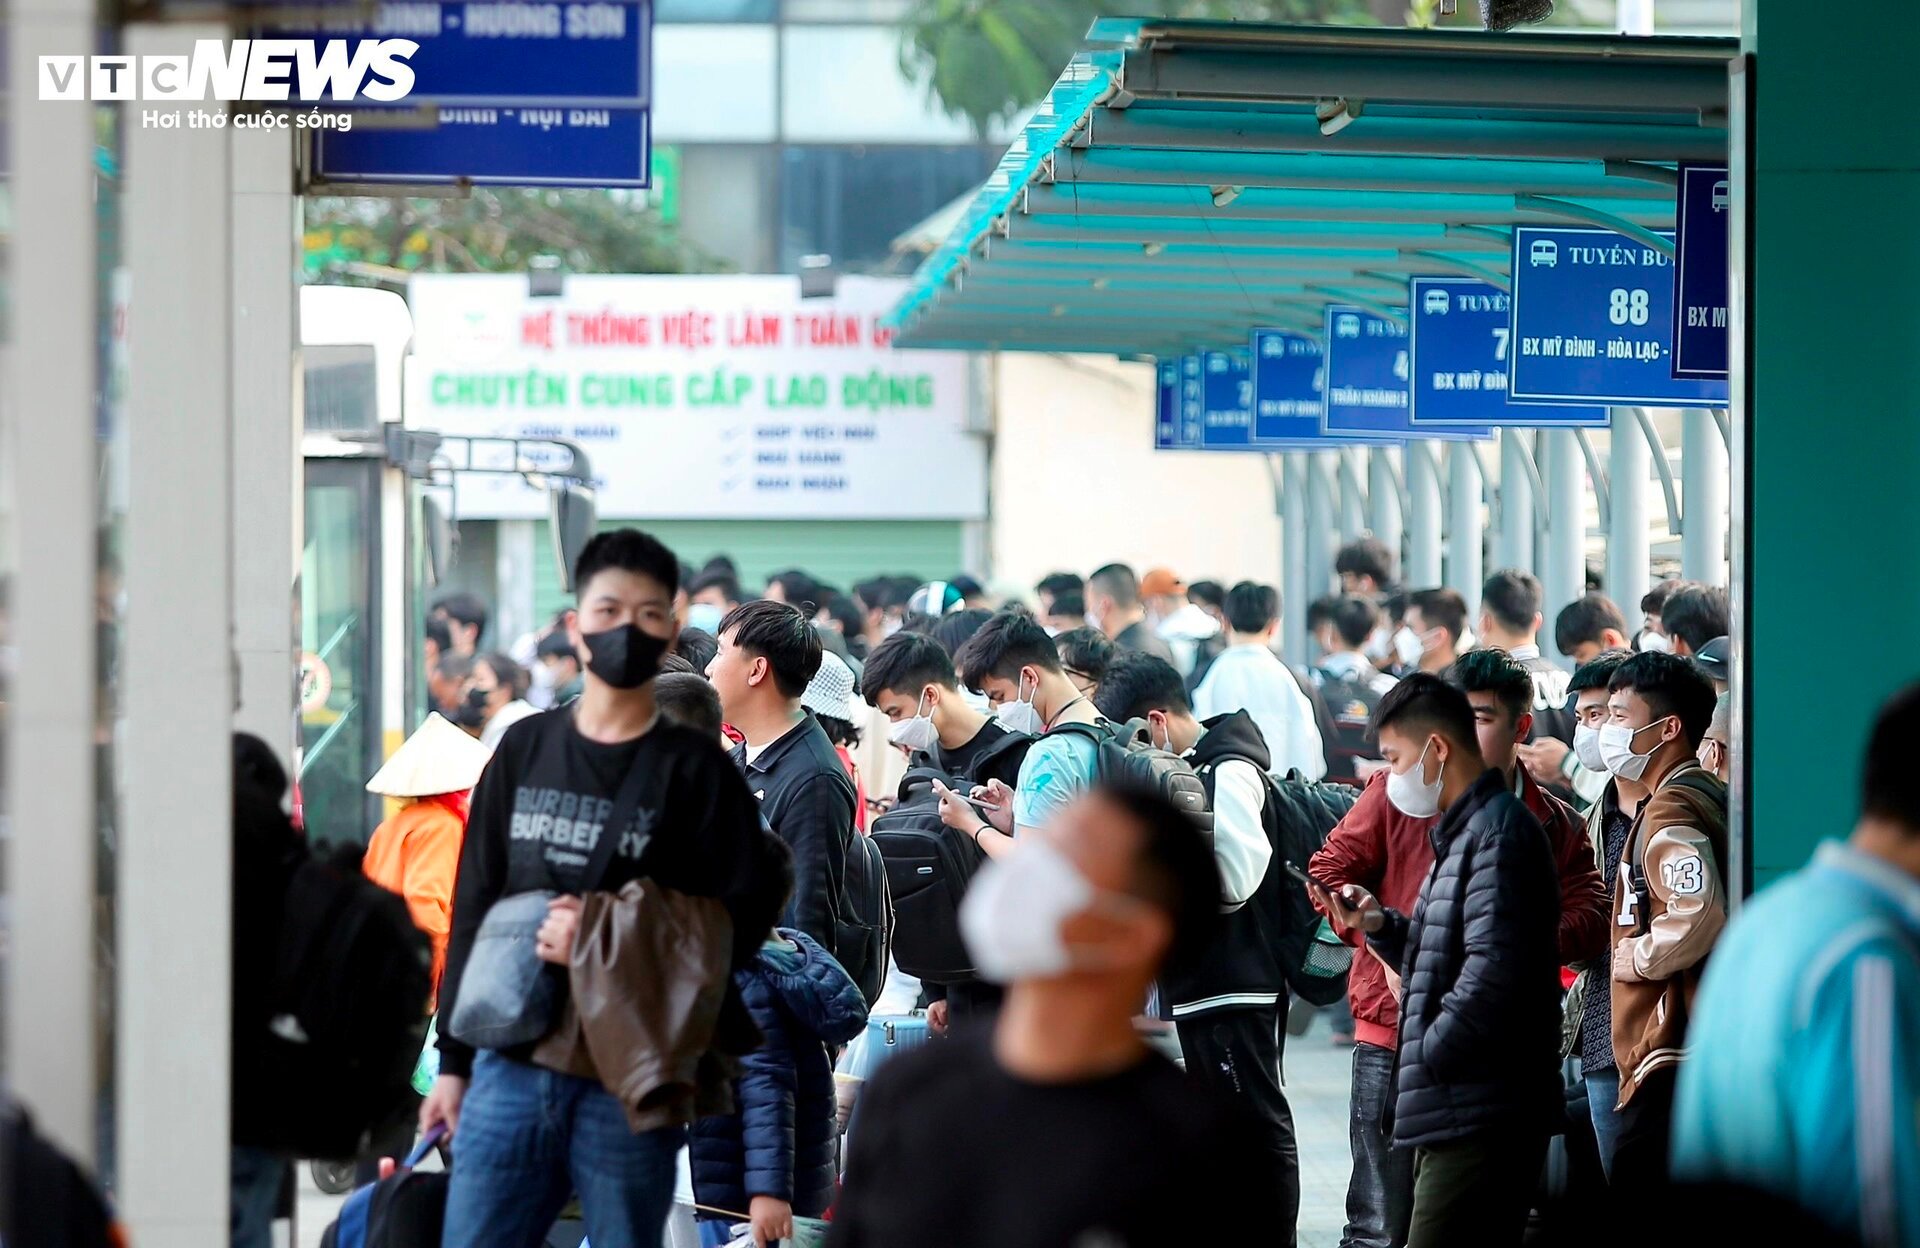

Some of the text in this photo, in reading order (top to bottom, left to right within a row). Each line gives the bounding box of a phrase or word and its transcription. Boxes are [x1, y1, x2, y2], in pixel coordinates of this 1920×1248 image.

[1642, 250, 1675, 266] BU
[1457, 293, 1510, 312] TUYẾ
[1609, 288, 1649, 325] 88
[1688, 306, 1707, 327] BX
[1522, 337, 1540, 356] BX
[1543, 335, 1562, 356] MỸ
[1565, 335, 1595, 357] ĐÌNH
[1607, 336, 1633, 359] HÒA
[1635, 341, 1660, 363] LẠC
[432, 362, 936, 413] CHUYÊN CUNG CẤP LAO ĐỘNG
[1433, 373, 1454, 390] BX
[514, 786, 655, 832] BURBERY
